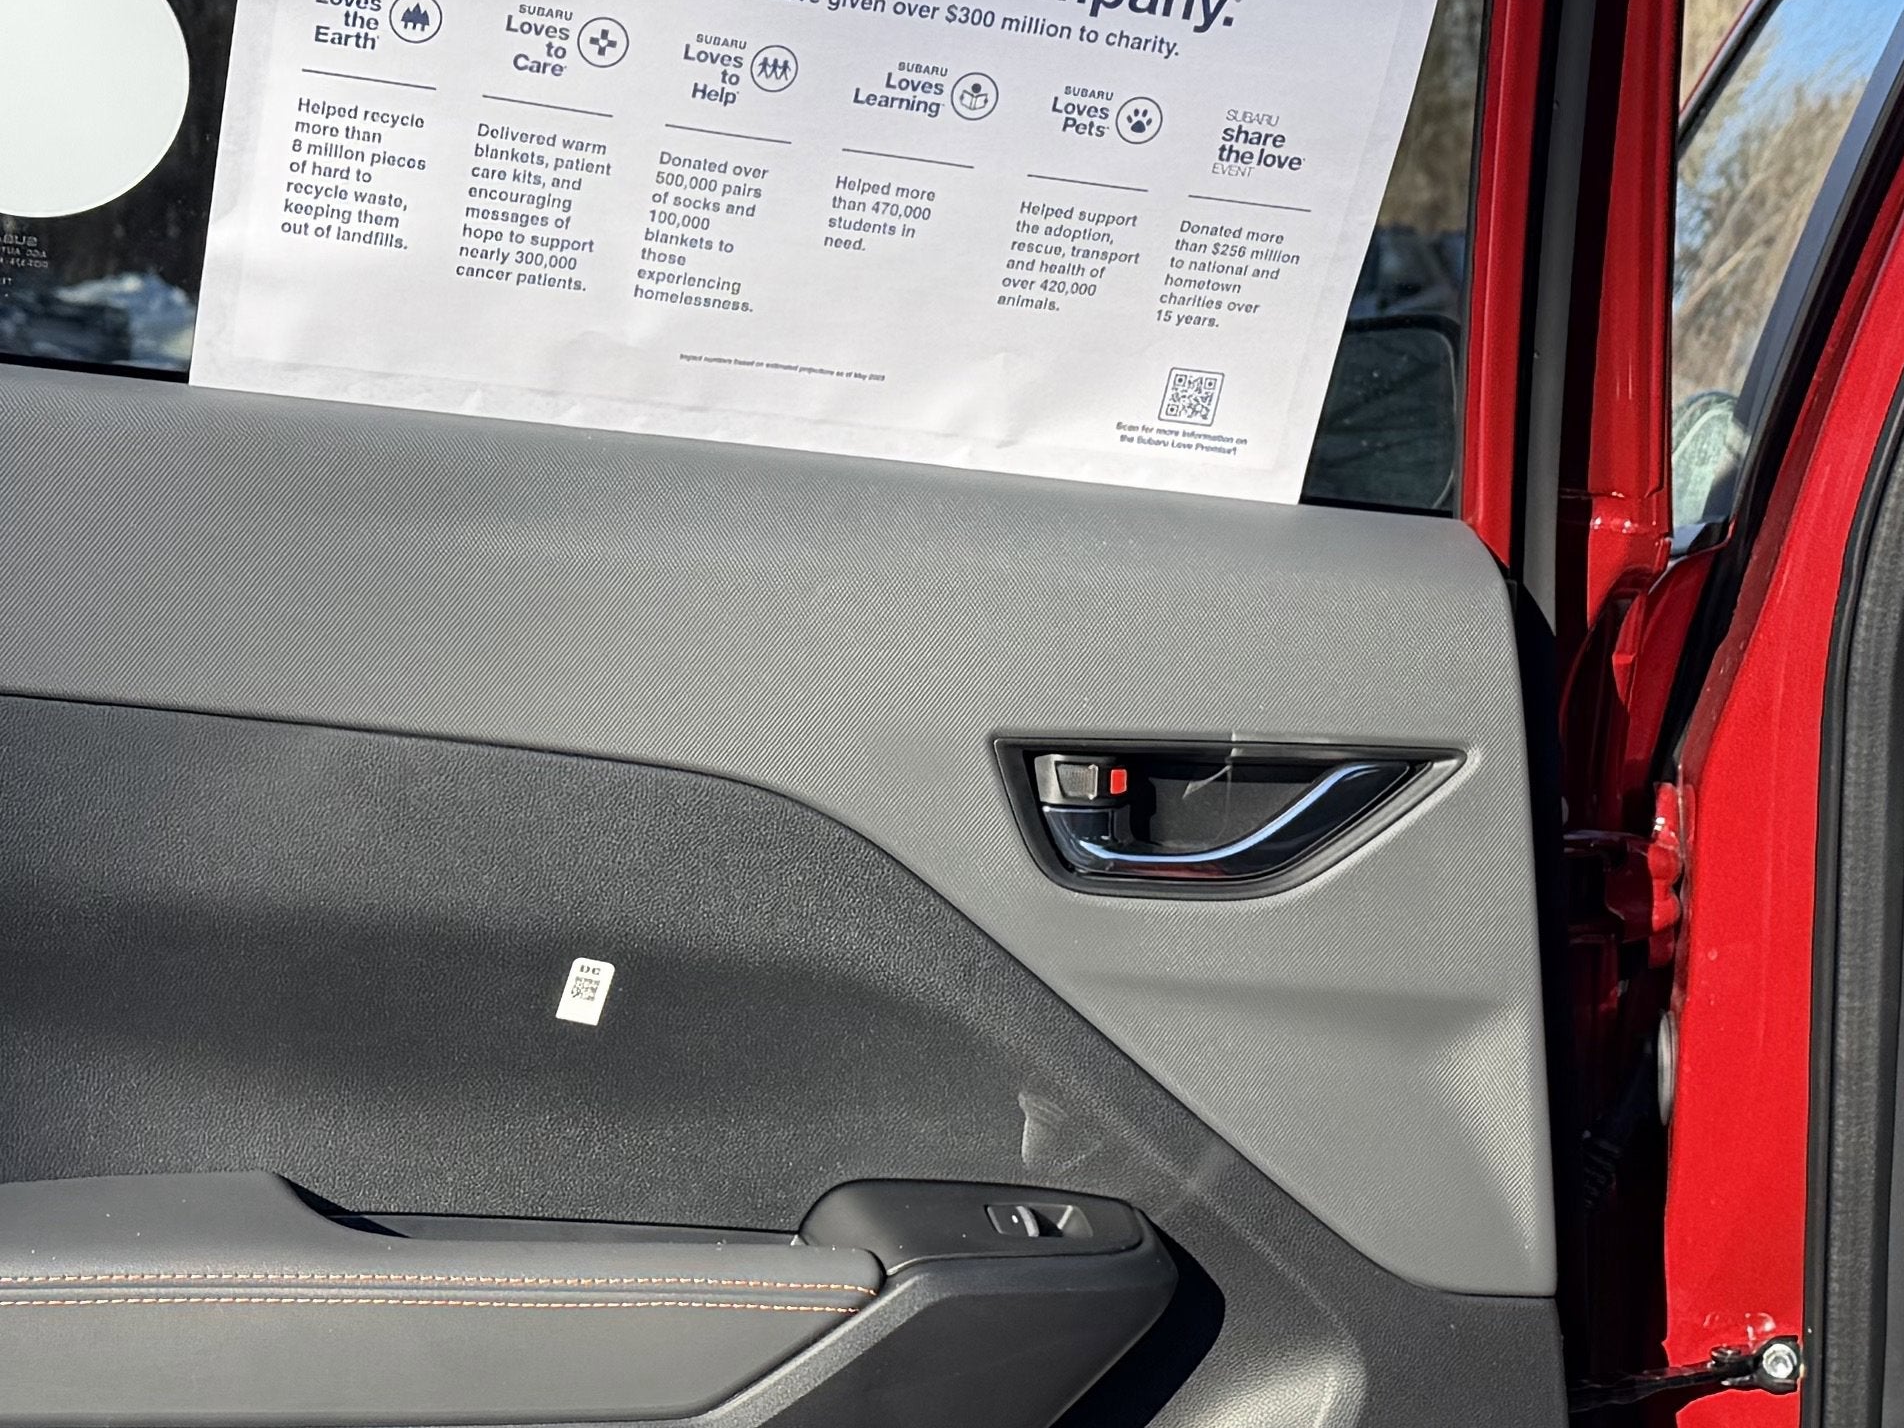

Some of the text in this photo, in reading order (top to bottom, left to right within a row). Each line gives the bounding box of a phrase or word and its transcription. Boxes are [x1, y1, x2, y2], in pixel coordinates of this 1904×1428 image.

[344, 10, 379, 30] the
[518, 4, 573, 21] SUBARU
[505, 15, 570, 41] Loves
[893, 0, 940, 20] over
[945, 4, 995, 29] $300
[1001, 15, 1072, 40] million
[1078, 25, 1099, 44] to
[1105, 29, 1180, 58] charity.
[545, 42, 567, 60] to
[696, 33, 747, 50] SUBARU
[683, 43, 744, 69] Loves
[721, 68, 740, 87] to
[897, 61, 948, 77] SUBARU
[885, 73, 944, 96] Loves
[1064, 86, 1114, 101] SUBARU
[297, 97, 425, 129] Helped recycle
[1052, 96, 1110, 120] Loves
[1225, 109, 1280, 127] SUBARU
[295, 120, 382, 144] more than
[477, 123, 607, 155] Delivered warm
[1222, 125, 1286, 149] share
[292, 139, 426, 171] 8 million pieces
[474, 144, 612, 176] blankets, patient
[659, 152, 769, 180] Donated over
[289, 160, 372, 183] of hard to
[471, 166, 582, 191] care kits, and
[1211, 163, 1255, 178] EVENT
[286, 180, 408, 212] recycle waste,
[655, 171, 763, 200] 500,000 pairs
[835, 176, 936, 202] Helped more
[468, 185, 572, 212] encouraging
[652, 191, 756, 218] of socks and
[832, 195, 931, 222] than 470,000
[283, 199, 400, 228] keeping them
[465, 205, 572, 231] messages of
[649, 210, 711, 232] 100,000
[1019, 201, 1138, 228] Helped support
[281, 221, 409, 251] out of landfills.
[463, 225, 594, 254] hope to support
[828, 216, 916, 239] students in
[1015, 220, 1114, 245] the adoption,
[1180, 220, 1284, 245] Donated more
[644, 228, 735, 254] blankets to
[824, 235, 866, 252] need.
[1011, 240, 1140, 266] rescue, transport
[1174, 239, 1301, 265] than $256 million
[459, 245, 577, 271] nearly 300,000
[640, 247, 687, 267] those
[1006, 257, 1106, 280] and health of
[1170, 256, 1281, 281] to national and
[456, 264, 587, 292] cancer patients.
[637, 268, 742, 295] experiencing
[1002, 276, 1097, 297] over 420,000
[1164, 273, 1242, 294] hometown
[634, 285, 754, 313] homelessness.
[997, 294, 1061, 311] animals.
[1159, 292, 1261, 314] charities over
[1156, 309, 1220, 329] 15 years.
